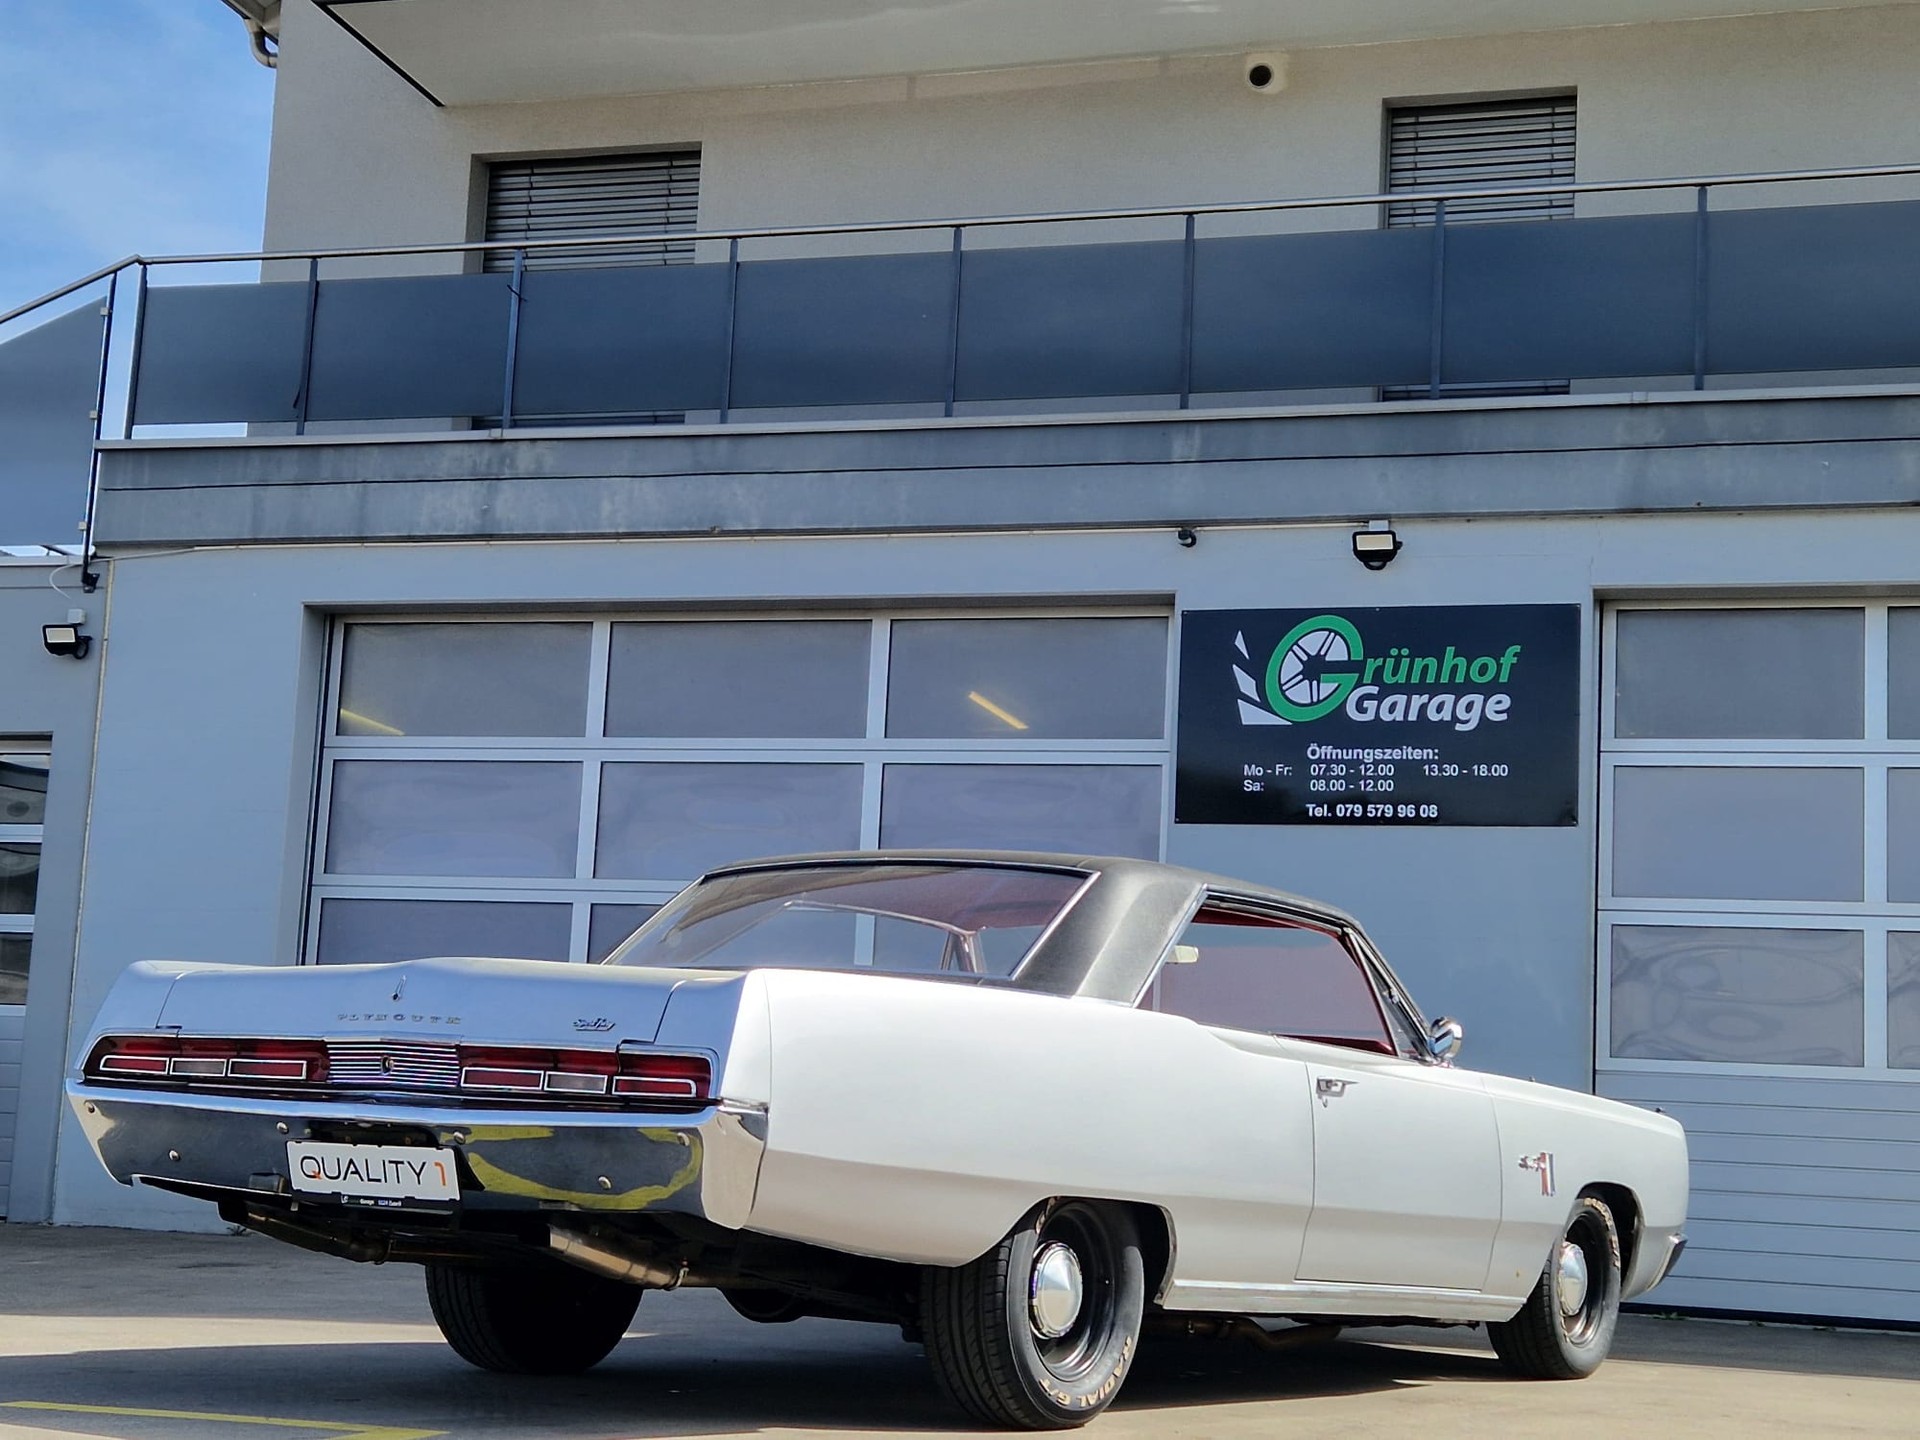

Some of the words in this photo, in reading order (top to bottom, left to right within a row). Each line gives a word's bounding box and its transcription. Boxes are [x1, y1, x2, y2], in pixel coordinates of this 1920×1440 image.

[1265, 614, 1522, 722] Grünhof
[1346, 685, 1511, 731] Garage
[1306, 743, 1439, 762] Öffnungszeiten:
[1243, 764, 1264, 776] Mo
[1275, 764, 1293, 776] Fr:
[1310, 764, 1346, 776] 07.30
[1359, 764, 1395, 776] 12.00
[1423, 764, 1459, 776] 13.30
[1472, 764, 1509, 776] 18.00
[1243, 780, 1265, 792] Sa:
[1310, 780, 1346, 792] 08.00
[1359, 780, 1394, 792] 12.00
[1306, 804, 1332, 817] Tel.
[1336, 804, 1363, 818] 079
[1367, 804, 1394, 818] 579
[1397, 804, 1416, 818] 96
[1419, 804, 1438, 818] 08
[300, 1155, 427, 1186] QUALITY
[433, 1161, 447, 1187] 1
